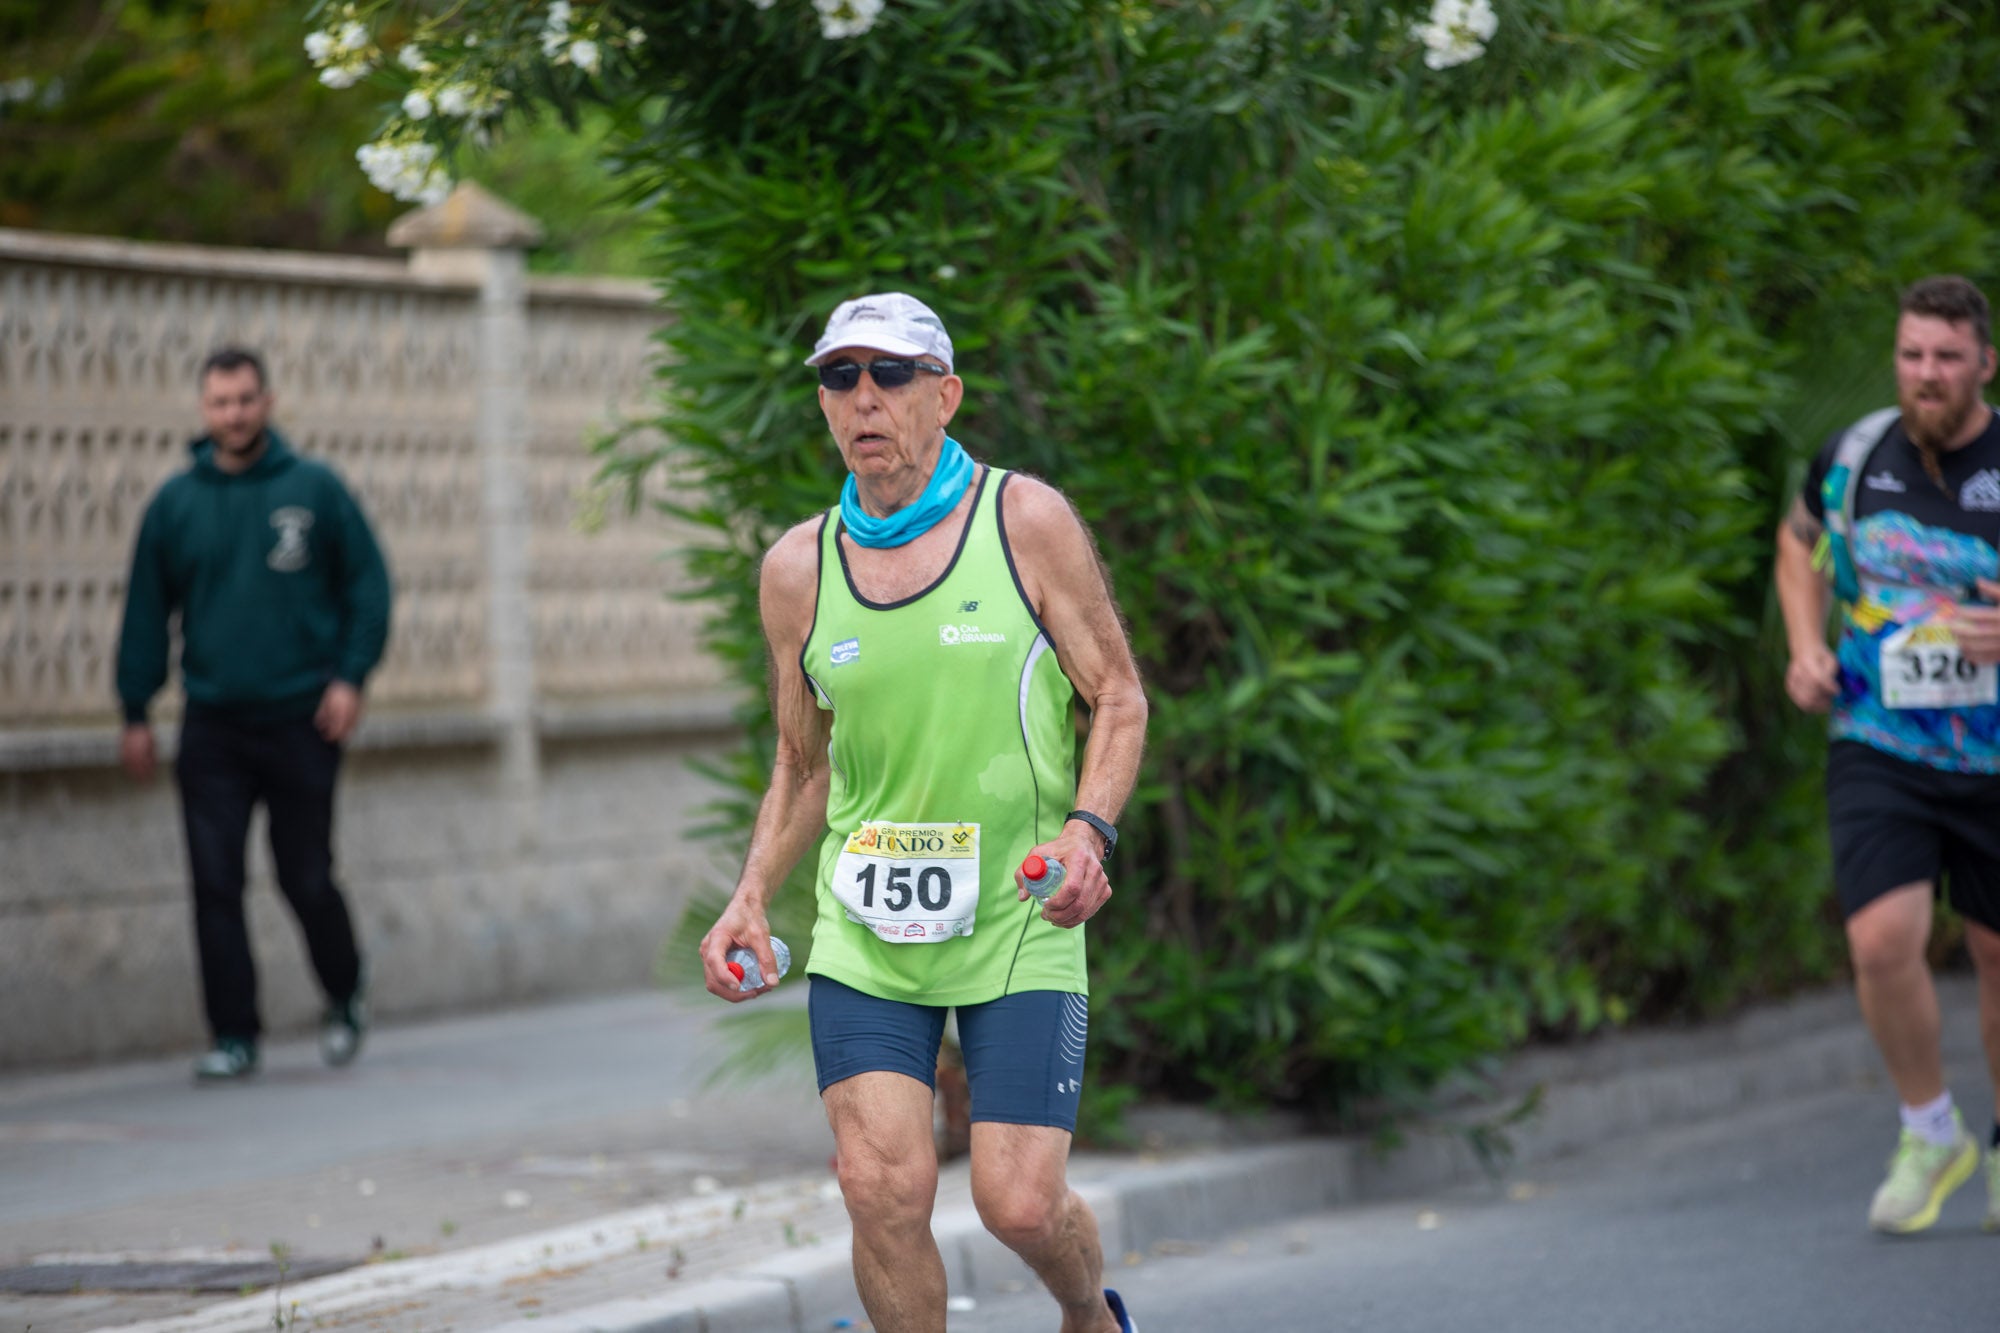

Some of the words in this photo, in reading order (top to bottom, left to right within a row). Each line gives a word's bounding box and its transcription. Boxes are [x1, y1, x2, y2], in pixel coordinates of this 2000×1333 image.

[961, 633, 1006, 643] GRANADA
[900, 829, 937, 837] PREMIO
[876, 834, 945, 852] FONDO
[856, 863, 952, 912] 150
